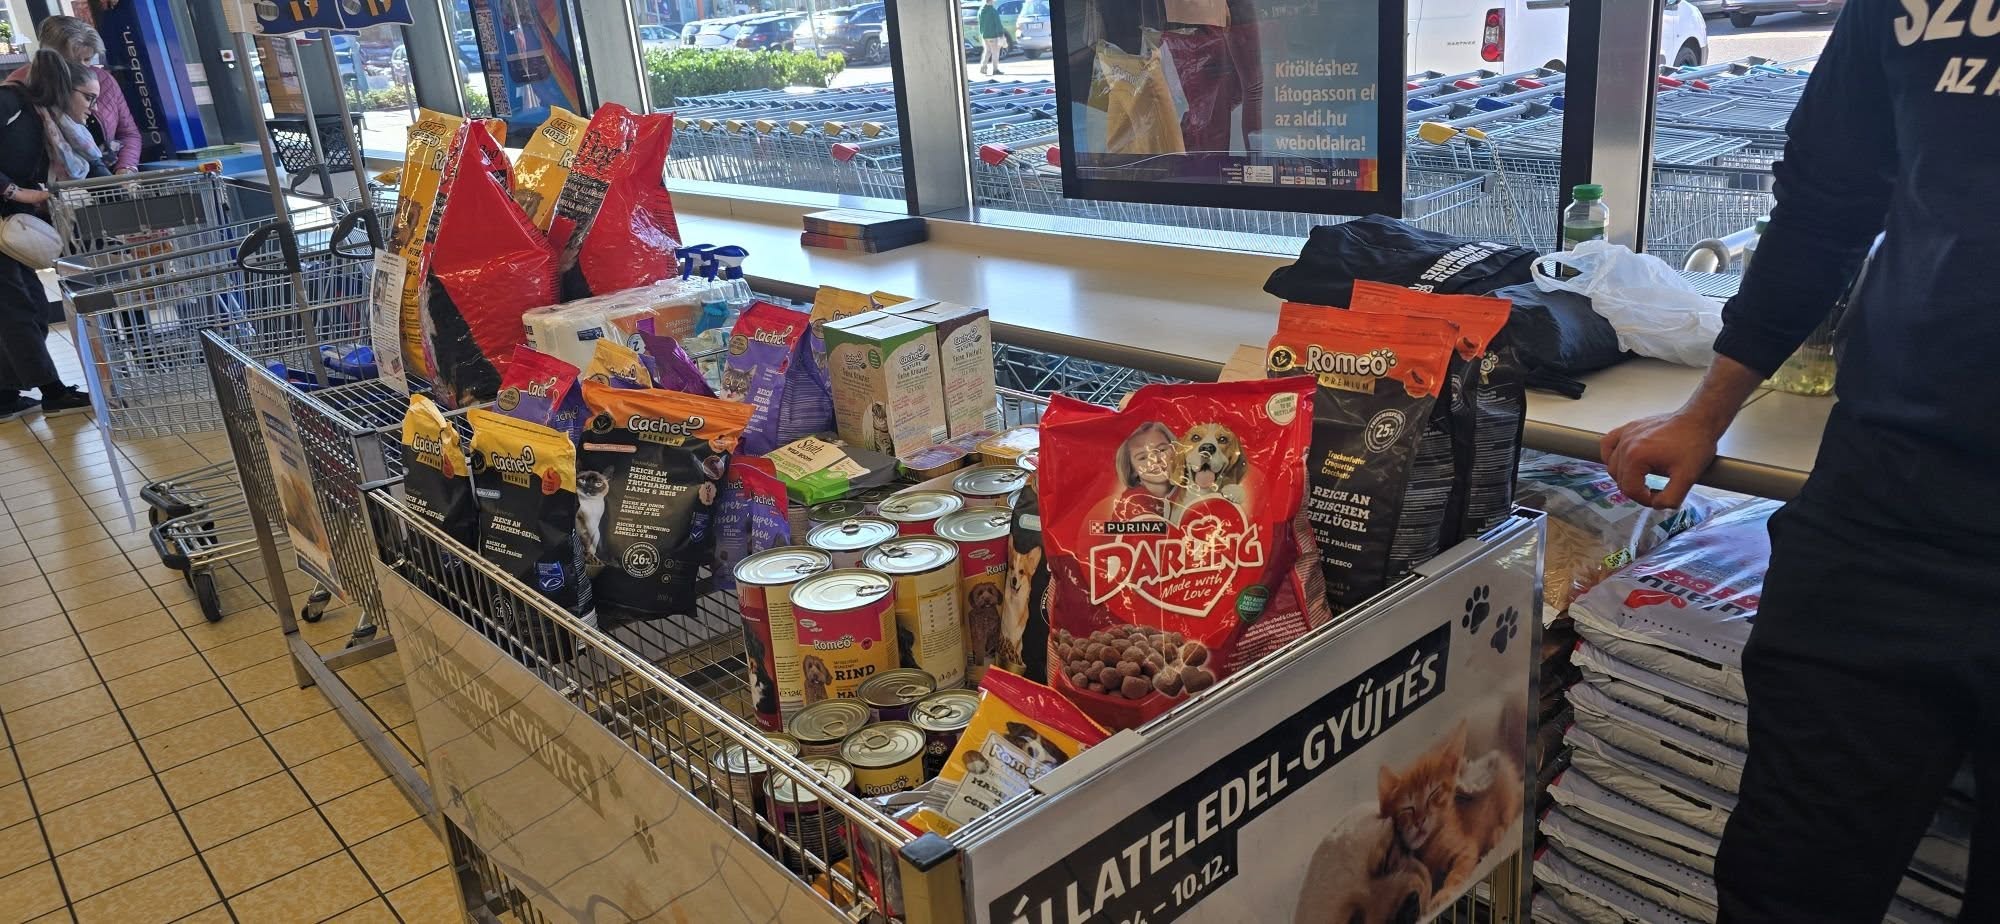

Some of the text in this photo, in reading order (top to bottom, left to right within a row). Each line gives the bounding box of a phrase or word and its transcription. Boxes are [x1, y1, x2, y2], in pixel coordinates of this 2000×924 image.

[1275, 58, 1359, 78] Kitöltéshez
[1934, 57, 1988, 94] AZ
[1275, 83, 1376, 106] látogasson el
[1275, 108, 1347, 127] az aldi.hu
[1275, 134, 1366, 152] weboldalra!
[1332, 168, 1358, 177] aldi.hu
[754, 325, 793, 344] Cachet
[1305, 345, 1392, 376] Romeo
[1324, 376, 1369, 390] PREMIUM
[628, 415, 705, 436] Cachet
[642, 434, 680, 444] PREMIUM
[491, 445, 536, 474] Cachet
[628, 472, 667, 484] FRISCHEM
[630, 466, 668, 478] REICH AN
[625, 485, 650, 495] LAMM
[627, 479, 688, 493] TRUTHAHN MIT
[1313, 485, 1371, 506] REICH AN
[1308, 498, 1371, 520] FRISCHEM
[1107, 522, 1161, 533] PURINA
[1306, 510, 1368, 533] GEFLÜGEL
[1331, 539, 1363, 551] FRAÎCHE
[1090, 523, 1264, 606] DARLING
[1326, 557, 1353, 569] FRESCO
[1161, 572, 1223, 598] Made with
[1184, 587, 1212, 601] Love
[813, 635, 853, 650] Romeo
[835, 664, 876, 681] RIND
[866, 778, 905, 797] Romeo
[1171, 855, 1230, 907] 10.12.
